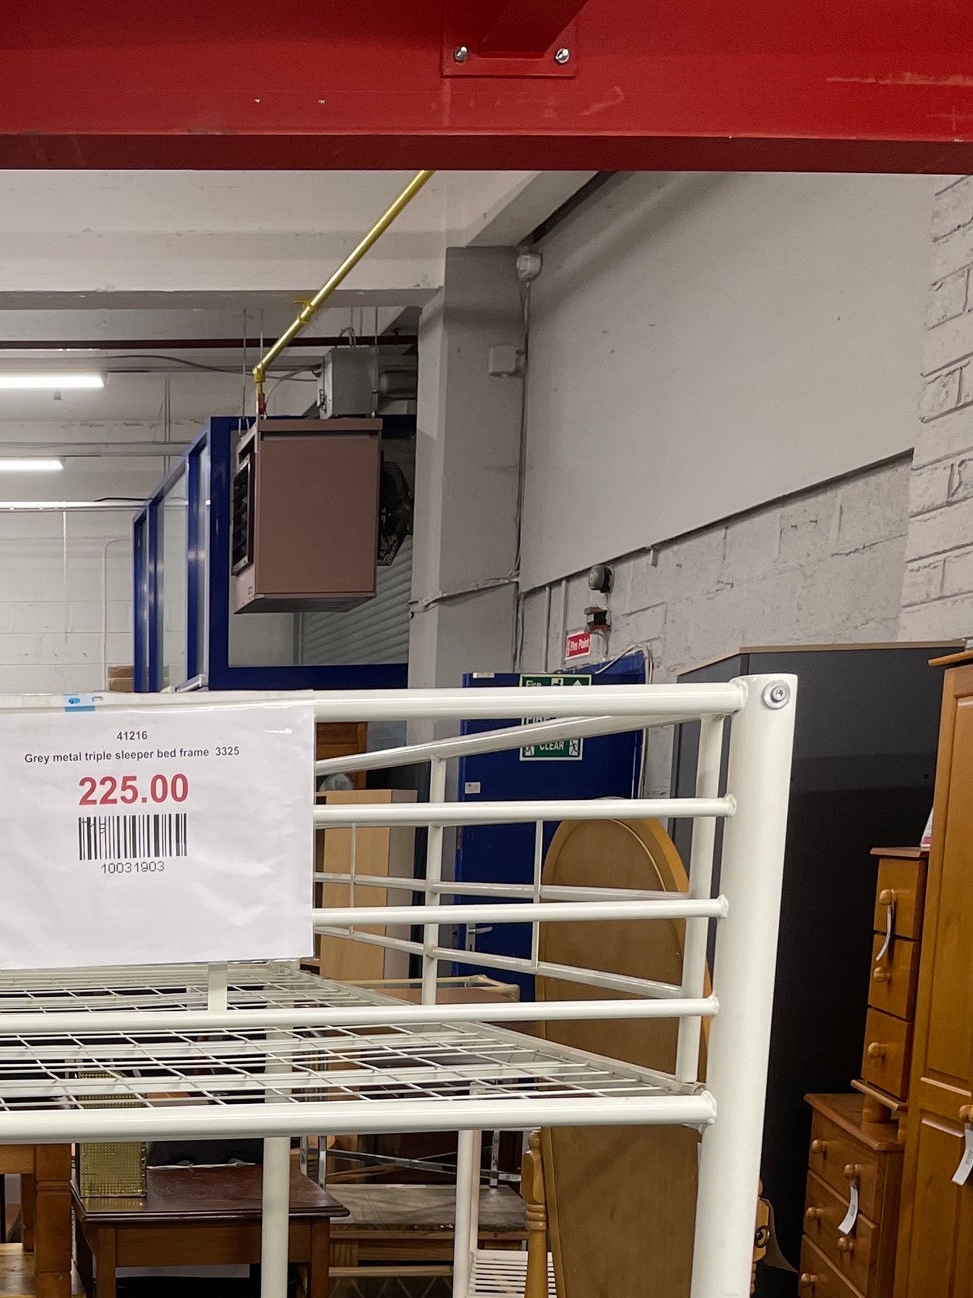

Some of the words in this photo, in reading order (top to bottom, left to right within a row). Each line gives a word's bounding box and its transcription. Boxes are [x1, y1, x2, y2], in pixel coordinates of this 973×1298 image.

[116, 730, 148, 741] 41216
[24, 753, 50, 765] Grey
[52, 751, 82, 763] metal
[84, 750, 112, 763] triple
[115, 750, 155, 762] sleeper
[156, 748, 177, 759] bed
[179, 747, 210, 758] frame
[215, 746, 240, 757] 3325
[78, 774, 189, 806] 225.00
[101, 861, 165, 874] 10031903
